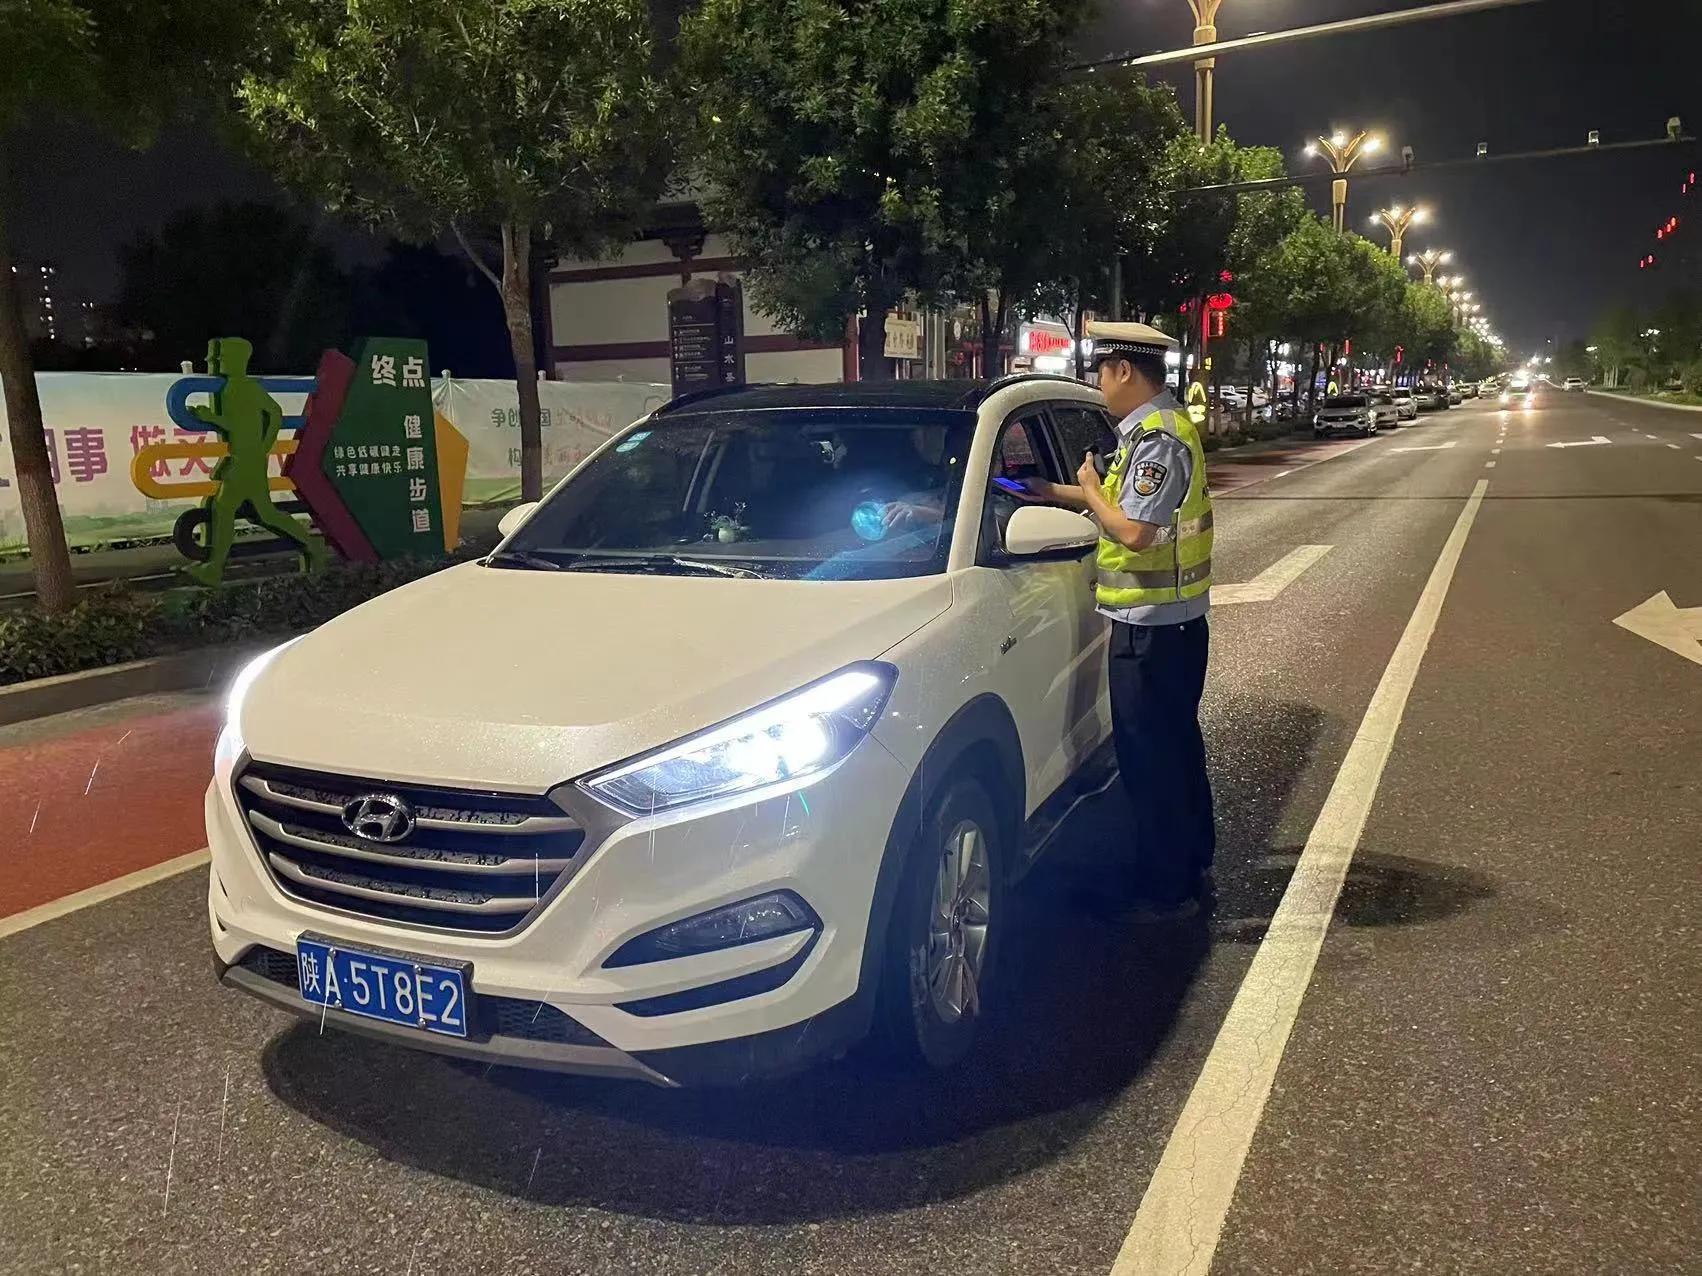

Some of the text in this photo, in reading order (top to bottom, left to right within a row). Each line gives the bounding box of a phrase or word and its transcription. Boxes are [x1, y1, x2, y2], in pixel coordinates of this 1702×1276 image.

[371, 354, 426, 388] 终点
[336, 461, 403, 477] 共享健康快乐
[403, 414, 431, 533] 健康步道
